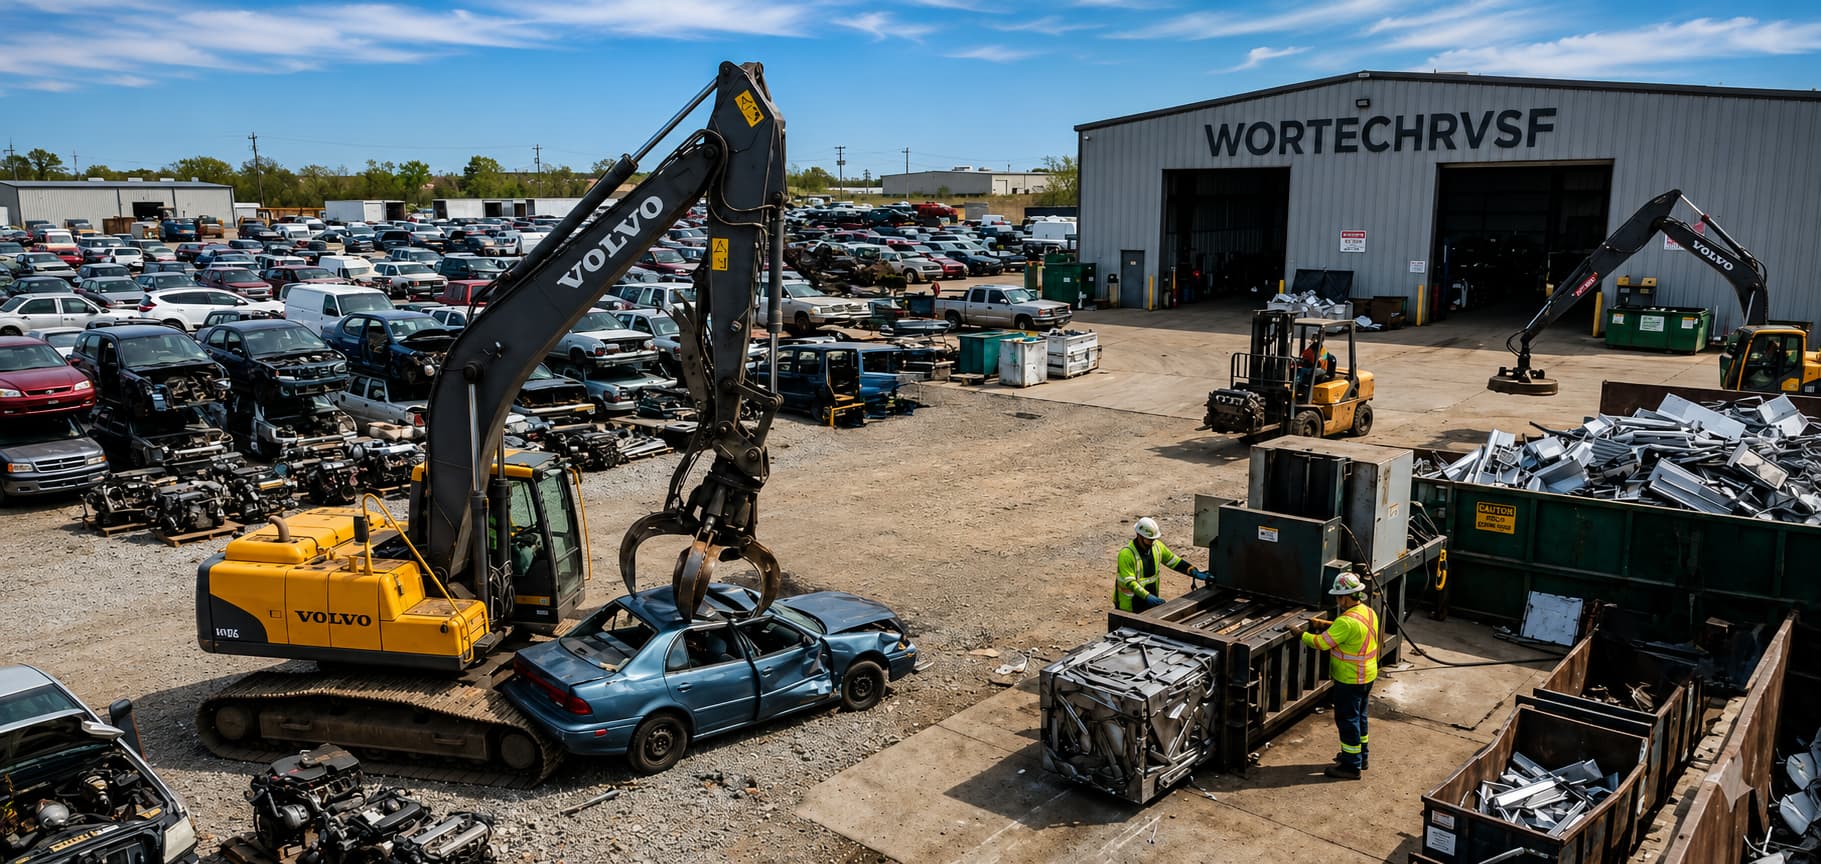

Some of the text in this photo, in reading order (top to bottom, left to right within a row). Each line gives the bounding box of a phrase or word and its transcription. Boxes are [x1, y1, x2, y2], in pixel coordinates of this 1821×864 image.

[1204, 107, 1557, 157] WORTECHRVSF
[556, 195, 664, 289] VOLVO
[1692, 240, 1734, 271] VOLVO
[294, 610, 372, 627] VOLVO
